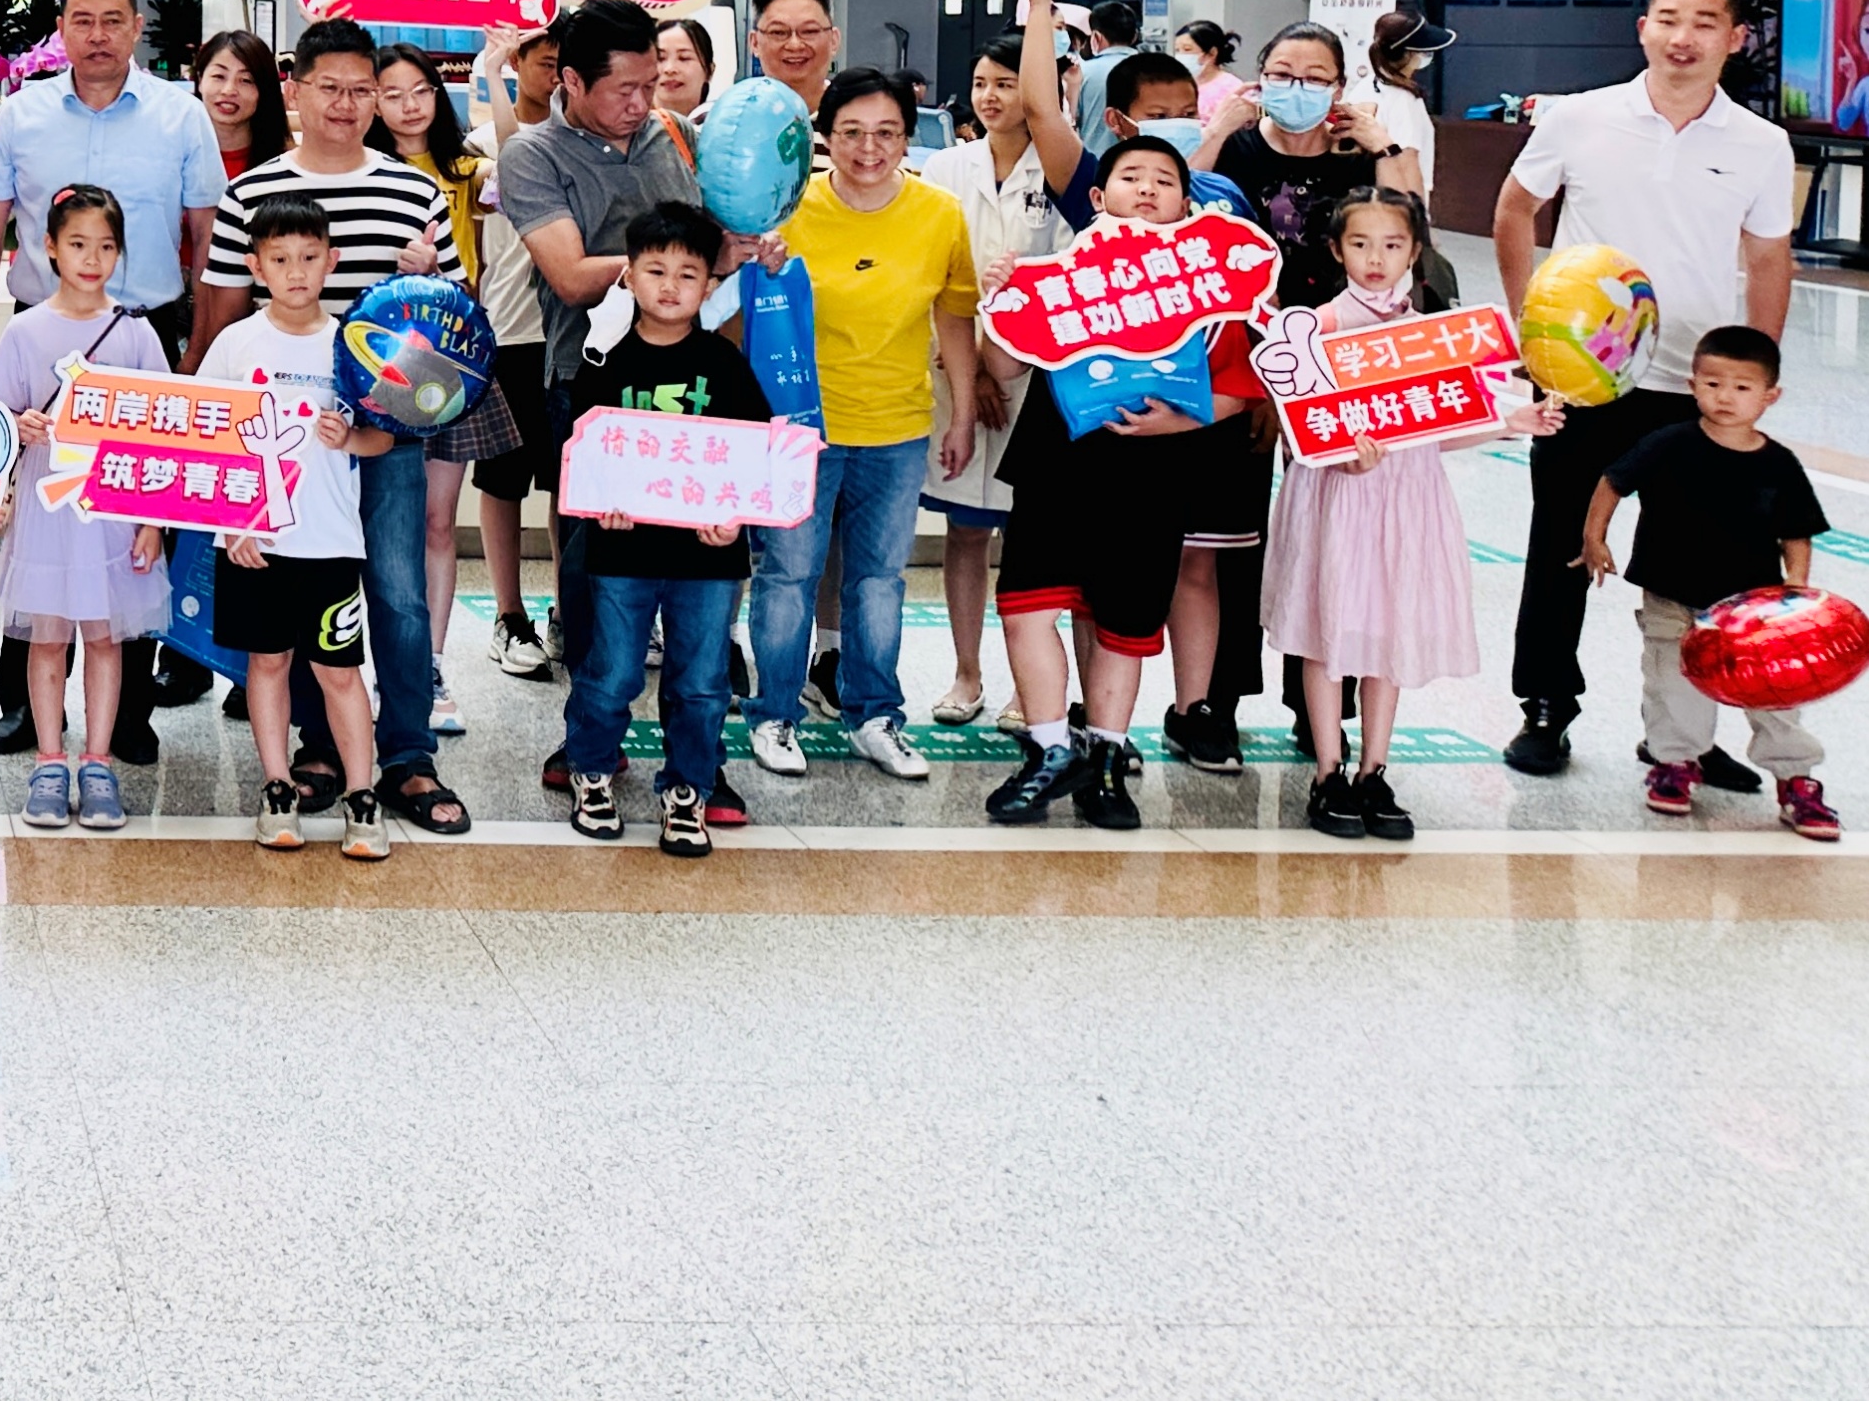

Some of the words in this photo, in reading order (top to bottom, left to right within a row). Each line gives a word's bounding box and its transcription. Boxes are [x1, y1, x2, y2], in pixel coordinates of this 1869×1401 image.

[1033, 235, 1217, 312] 青春心向党
[402, 302, 483, 343] BIRTHDAY
[1046, 271, 1233, 348] 建功新时代
[1334, 316, 1501, 379] 学习二十大
[70, 384, 233, 439] 两岸携手
[1304, 379, 1472, 443] 争做好青年
[600, 425, 731, 466] 情的交融
[99, 450, 262, 506] 筑梦青春
[644, 474, 774, 514] 心的共鸣
